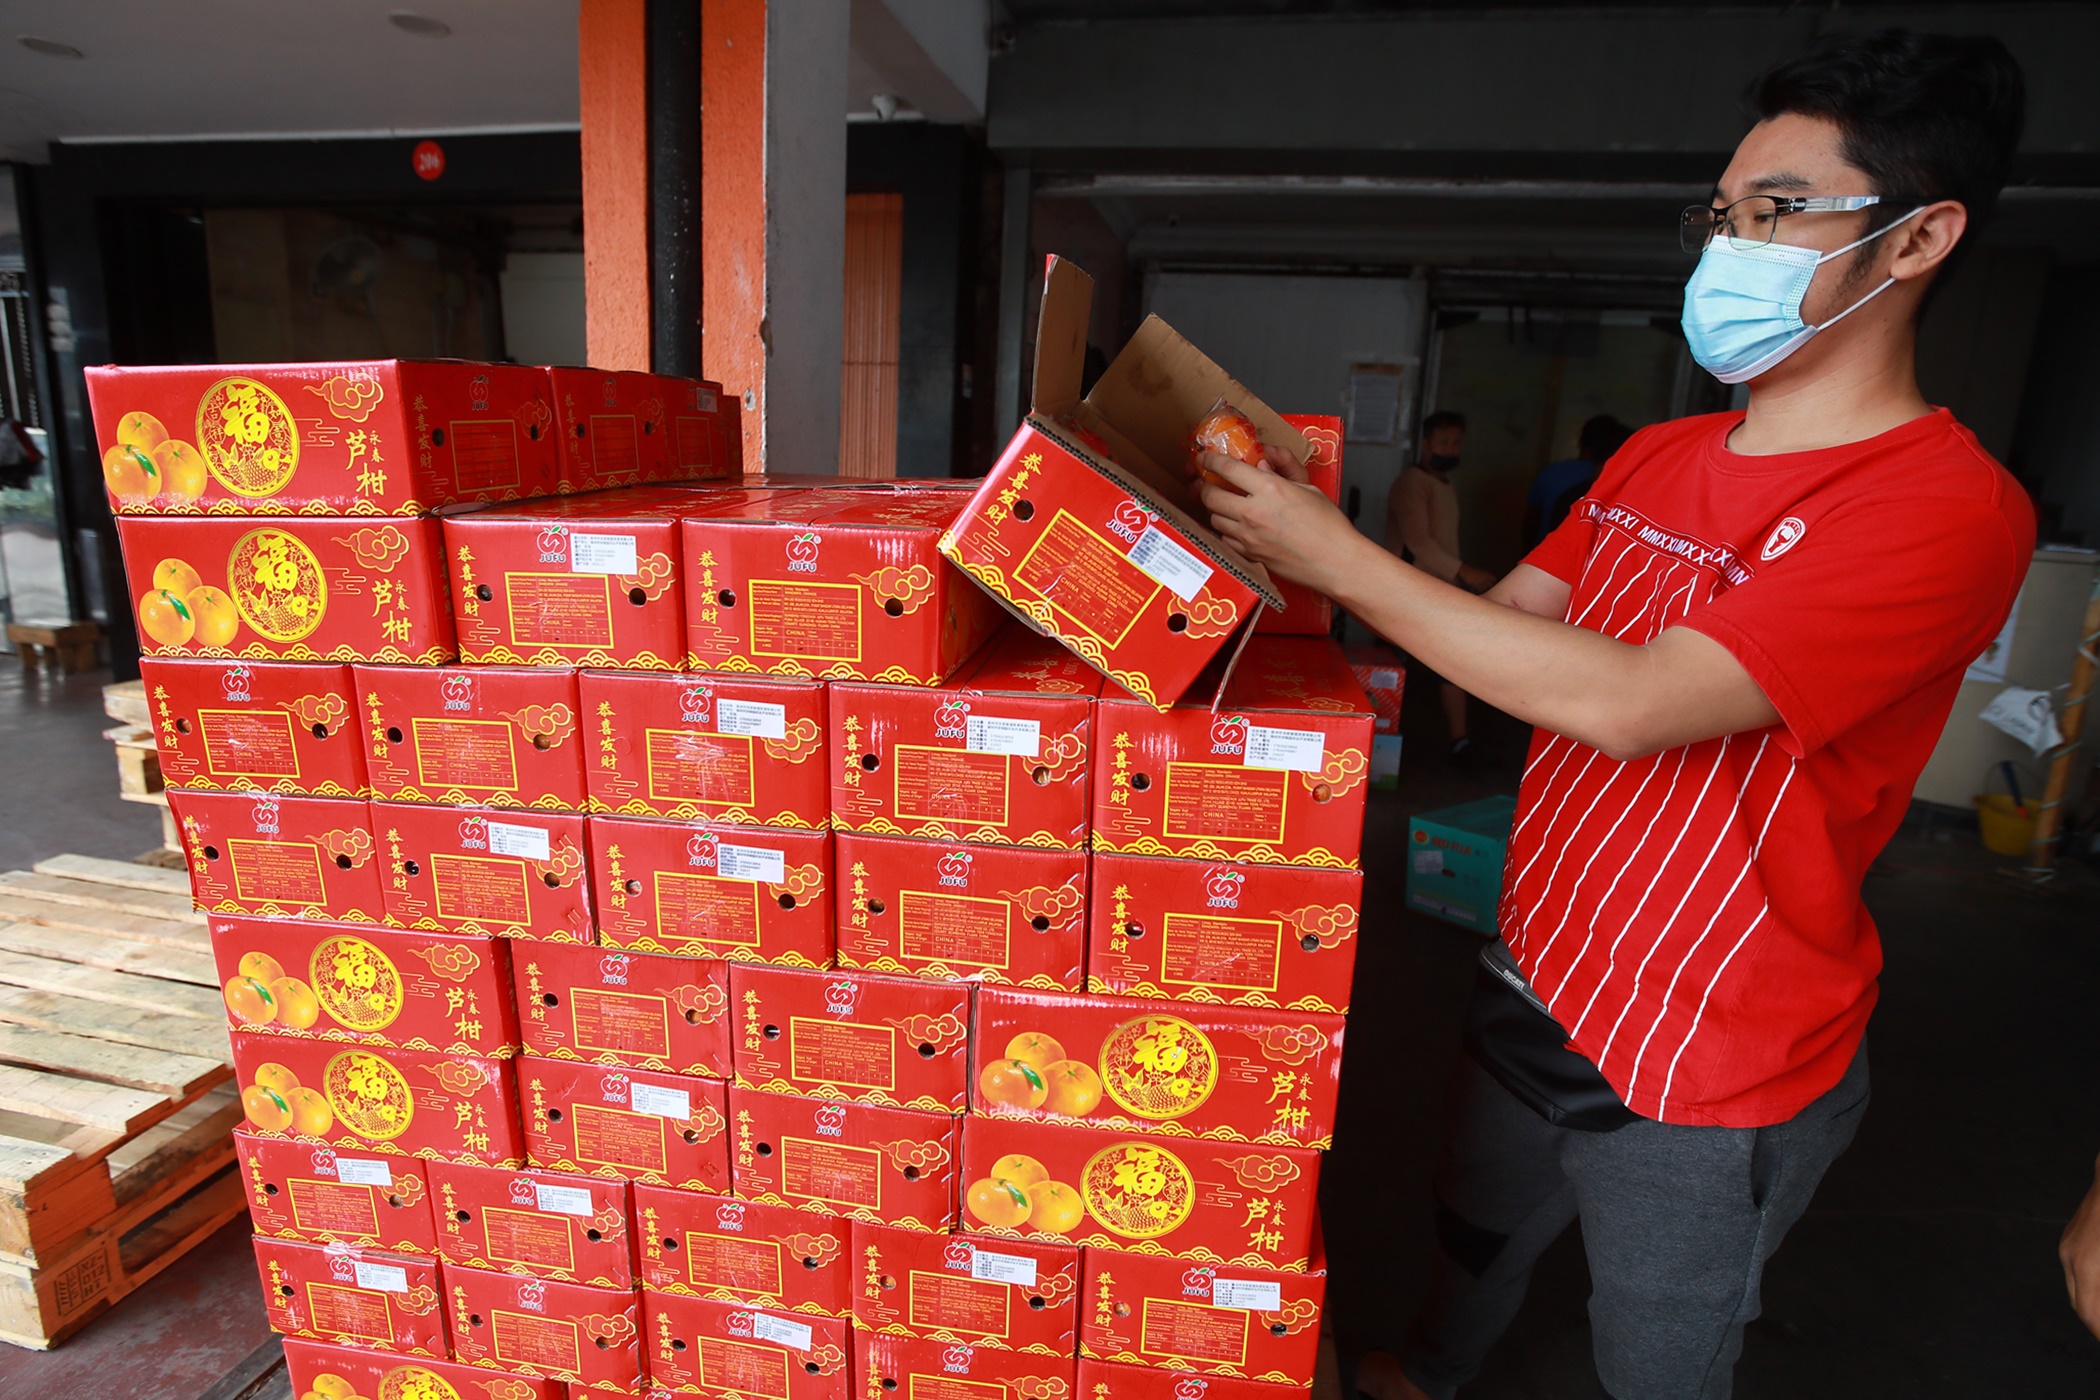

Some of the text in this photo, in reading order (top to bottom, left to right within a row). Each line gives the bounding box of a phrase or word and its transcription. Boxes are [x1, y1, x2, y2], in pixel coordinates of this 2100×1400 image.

[221, 383, 270, 443] 福
[413, 396, 433, 469] 恭喜发财
[345, 429, 388, 496] 芦柑
[369, 430, 384, 462] 永春
[983, 452, 1043, 526] 恭喜发财
[1105, 519, 1136, 544] JUFU
[252, 534, 298, 591] 福
[456, 545, 480, 617] 恭喜发财
[539, 553, 566, 563] JUFU
[788, 561, 816, 572] JUFU
[371, 578, 412, 643] 芦柑
[395, 580, 410, 611] 永春
[698, 550, 718, 624] 恭喜发财
[1060, 576, 1080, 594] CHINA
[153, 684, 179, 749] 恭喜发财
[365, 691, 388, 759] 恭喜发财
[445, 701, 470, 711] JUFU
[682, 713, 709, 722] JUFU
[596, 700, 618, 770] 恭喜发财
[842, 714, 863, 788] 恭喜发财
[935, 728, 965, 738] JUFU
[1211, 744, 1242, 754] JUFU
[1109, 731, 1134, 806] 恭喜发财
[1203, 811, 1224, 819] CHINA
[184, 815, 208, 875] 恭喜发财
[385, 827, 408, 891] 恭喜发财
[460, 841, 486, 849] JUFU
[688, 858, 715, 867] JUFU
[605, 844, 627, 910] 恭喜发财
[849, 861, 870, 929] 恭喜发财
[939, 876, 967, 887] JUFU
[1109, 883, 1134, 953] 恭喜发财
[1207, 898, 1238, 908] JUFU
[333, 941, 377, 988] 福
[602, 976, 627, 985] JUFU
[444, 988, 483, 1041] 芦柑
[467, 989, 481, 1014] 永春
[525, 962, 546, 1022] 恭喜发财
[827, 1005, 854, 1014] JUFU
[742, 989, 762, 1052] 恭喜发财
[1133, 1020, 1188, 1073] 福
[346, 1055, 388, 1101] 福
[1266, 1071, 1311, 1129] 芦柑
[1296, 1072, 1314, 1101] 永春
[454, 1101, 490, 1152] 芦柑
[475, 1104, 488, 1128] 永春
[529, 1078, 549, 1134] 恭喜发财
[816, 1126, 842, 1136] JUFU
[736, 1109, 754, 1168] 恭喜发财
[248, 1156, 269, 1207] 恭喜发财
[1113, 1147, 1167, 1196] 福
[441, 1182, 460, 1234] 恭喜发财
[643, 1207, 661, 1259] 恭喜发财
[1240, 1198, 1285, 1252] 芦柑
[1272, 1201, 1287, 1226] 永春
[267, 1260, 287, 1309] 恭喜发财
[863, 1245, 882, 1300] 恭喜发财
[945, 1261, 971, 1270] JUFU
[453, 1285, 470, 1336] 恭喜发财
[1094, 1271, 1116, 1328] 恭喜发财
[1182, 1288, 1209, 1297] JUFU
[656, 1312, 674, 1362] 恭喜发财
